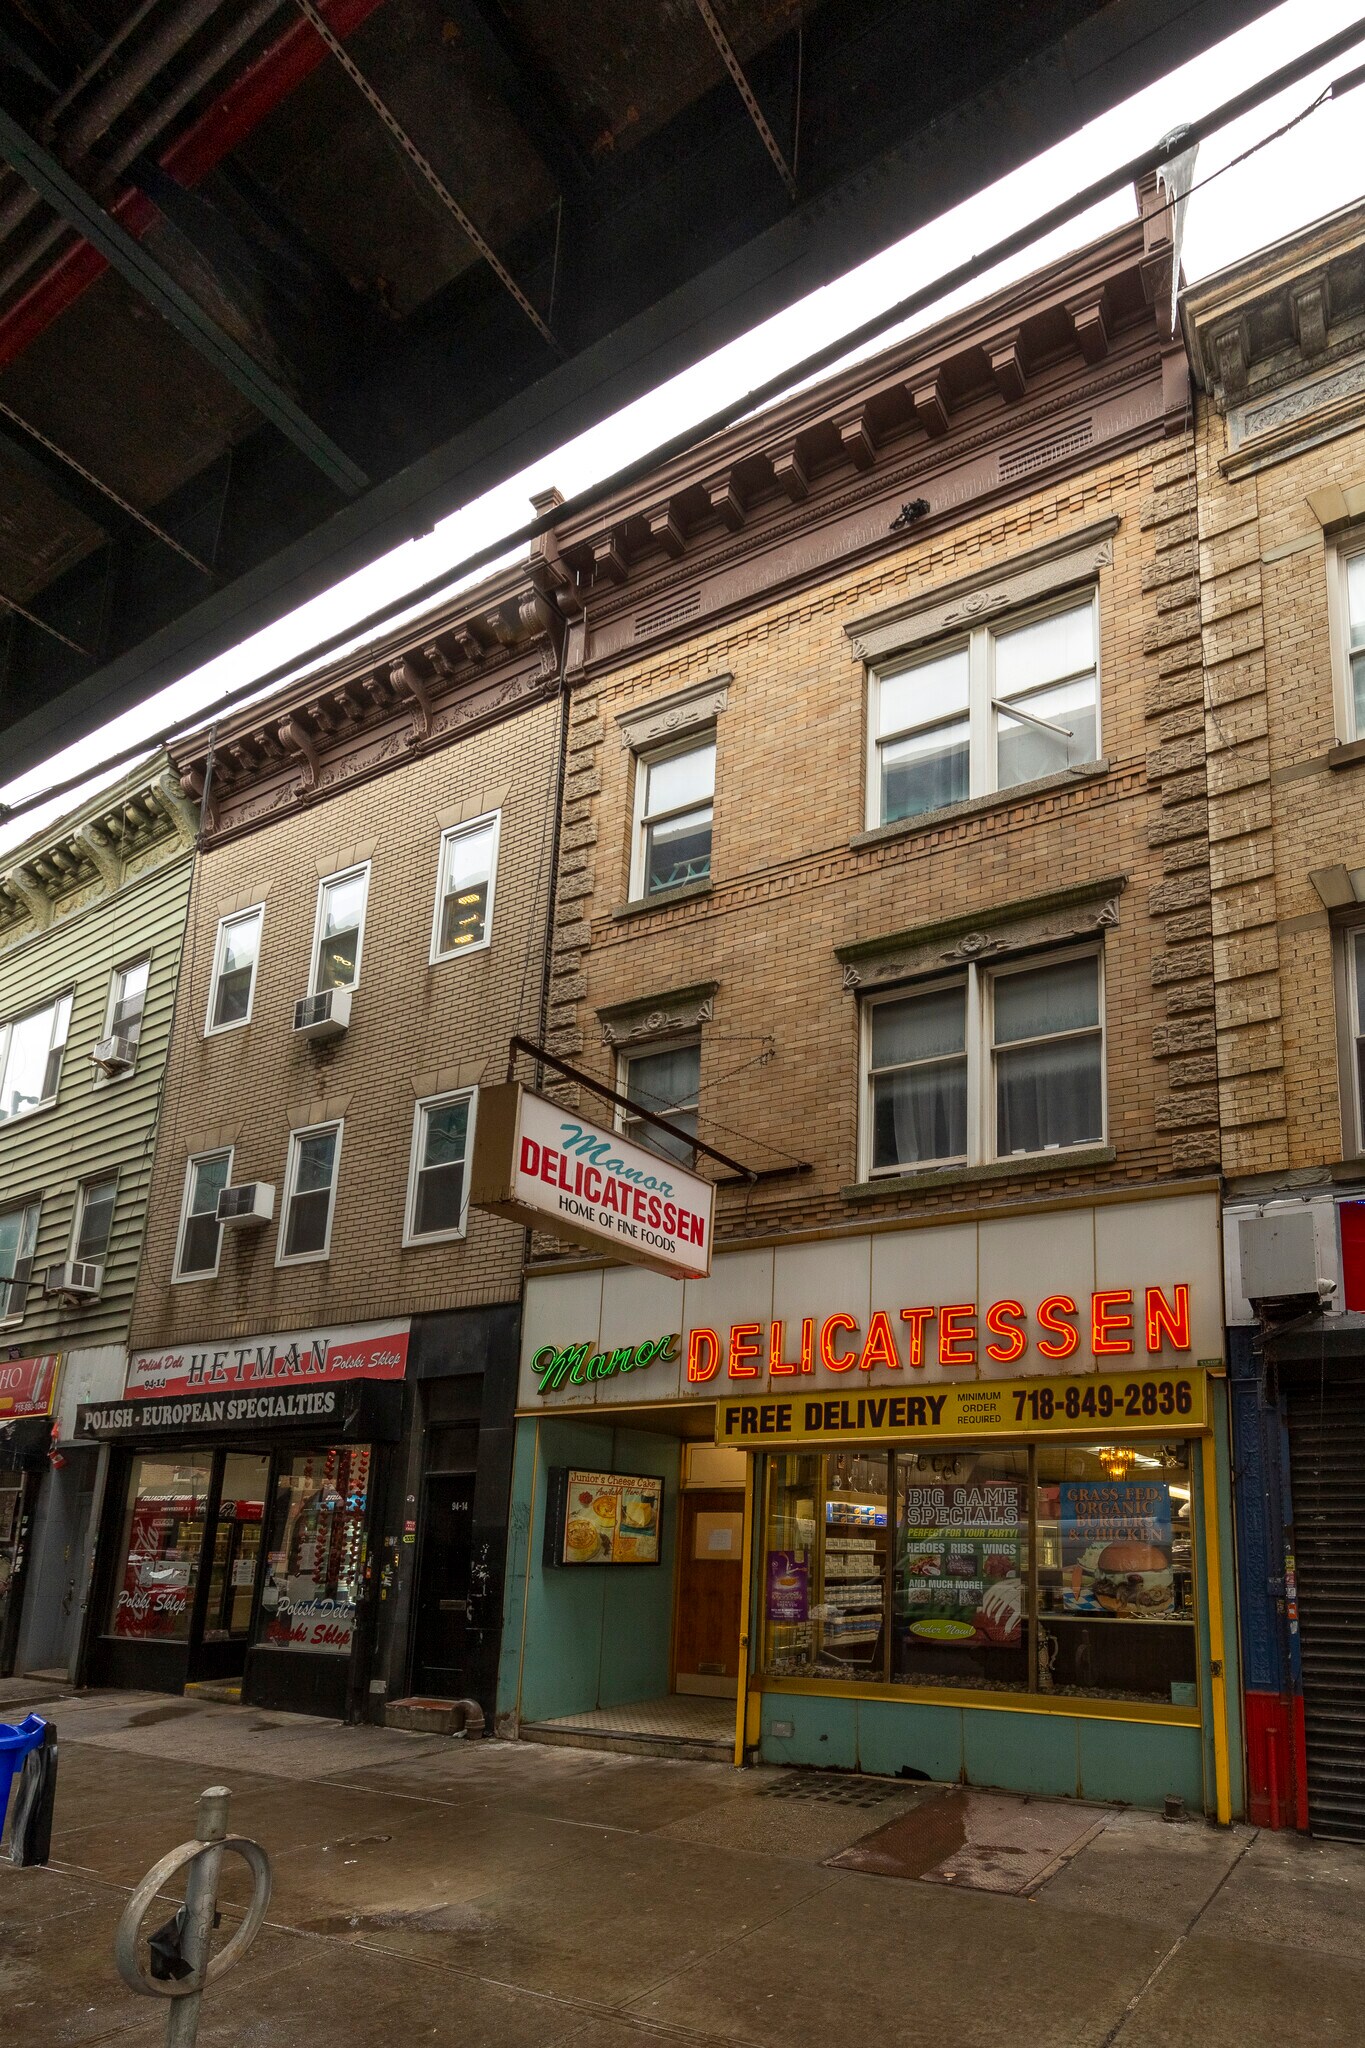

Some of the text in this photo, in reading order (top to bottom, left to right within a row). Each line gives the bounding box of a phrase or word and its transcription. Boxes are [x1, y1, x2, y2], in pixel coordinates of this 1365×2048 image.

[560, 1123, 675, 1198] Manor
[519, 1136, 705, 1247] DELICATESSEN
[559, 1195, 676, 1253] HOME OF FINE FOODS
[530, 1283, 1191, 1395] Manor DELICATESSEN
[137, 1355, 185, 1373] Polish Deli
[186, 1338, 330, 1387] HETMAN
[331, 1351, 401, 1372] Polski Sklep
[0, 1367, 22, 1390] HO
[144, 1377, 166, 1390] 94-14
[957, 1391, 1001, 1402] MINIMUM
[1012, 1380, 1193, 1422] 718-849-2836
[83, 1409, 133, 1431] POLISH
[142, 1401, 223, 1426] EUROPEAN
[226, 1391, 336, 1420] SPECIALTIES
[725, 1394, 947, 1435] FREE DELIVERY
[962, 1403, 997, 1413] ORDER
[957, 1414, 1001, 1424] REQUIRED
[571, 1471, 656, 1488] Junior's Cheese Cake
[908, 1488, 1018, 1507] BIG GAME
[1067, 1487, 1162, 1502] GRASS-FED,
[907, 1507, 1018, 1526] SPECIALS
[1075, 1501, 1154, 1514] ORGANIC
[1076, 1515, 1154, 1528] BURGERS
[908, 1528, 1018, 1538] PERFECT FOR YOUR PARTY!
[1068, 1528, 1163, 1541] & CHICKEN
[907, 1542, 1016, 1555] HEROES RIBS WINGS
[909, 1580, 983, 1590] AND MUCH MORE!
[117, 1590, 186, 1615] Polski Sklep
[276, 1596, 350, 1619] Polish Deli
[310, 1623, 351, 1649] Sklep
[911, 1623, 974, 1635] Order Now!
